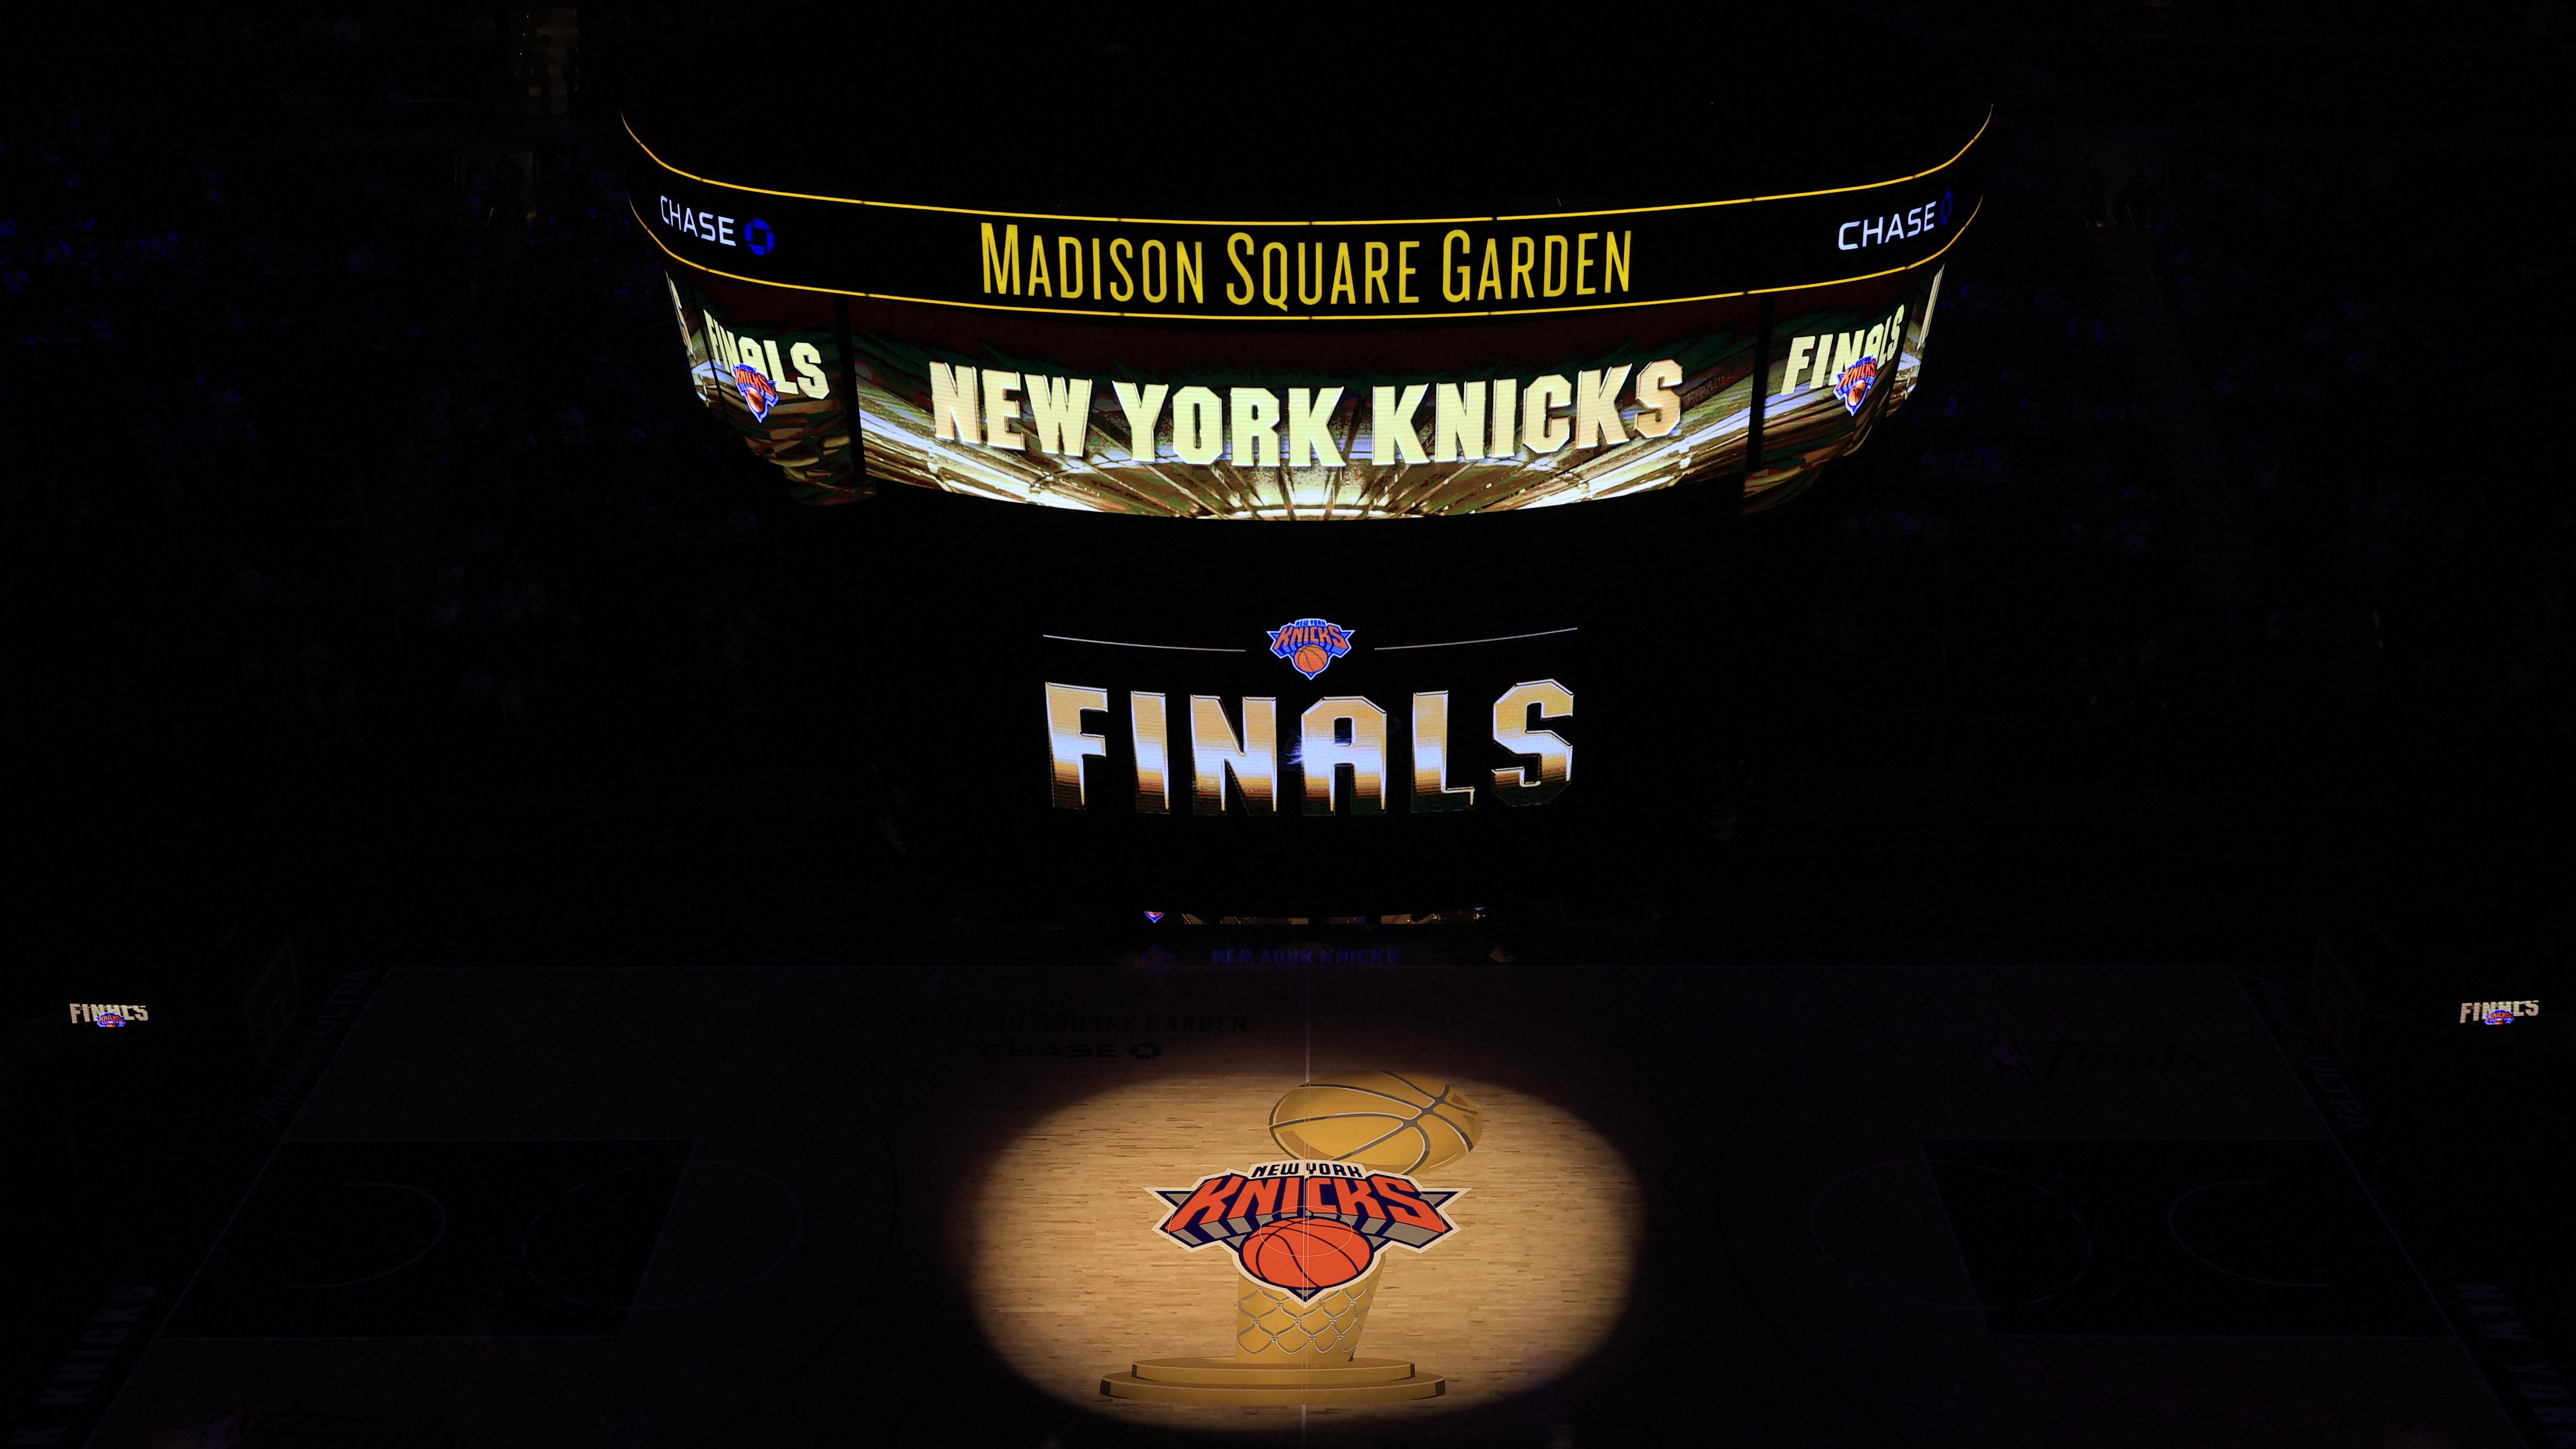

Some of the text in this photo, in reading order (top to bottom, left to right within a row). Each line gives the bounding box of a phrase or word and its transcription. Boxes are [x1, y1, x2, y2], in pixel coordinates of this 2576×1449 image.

[661, 195, 737, 246] CHASE
[1838, 201, 1937, 251] CHASE
[981, 222, 1632, 311] MADISON SQUARE GARDEN
[1837, 358, 1876, 390] KNICKS
[929, 359, 1683, 467] NEW YORK KNICKS
[1274, 625, 1349, 651] KNICKS
[1045, 679, 1574, 816] FINALS
[1251, 1163, 1363, 1178] NEW YORK
[1164, 1175, 1450, 1235] KNICKS
